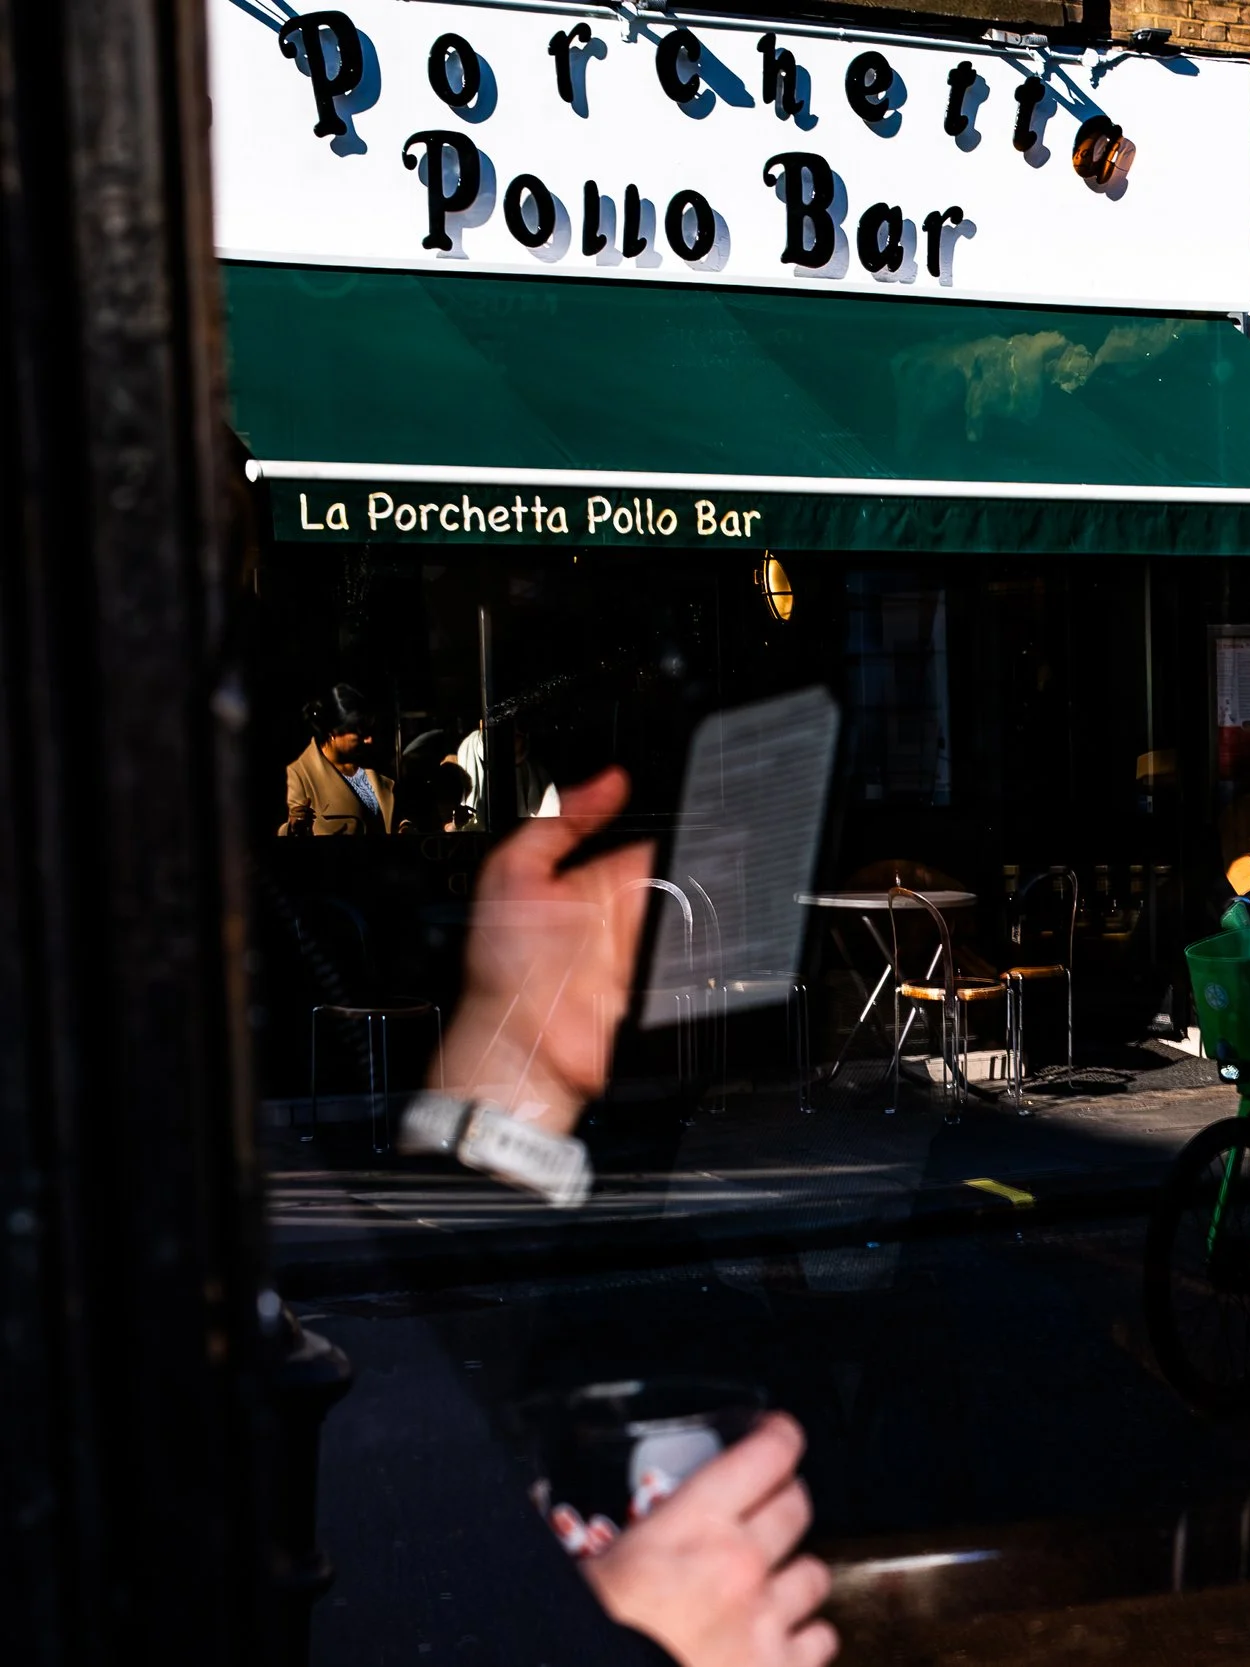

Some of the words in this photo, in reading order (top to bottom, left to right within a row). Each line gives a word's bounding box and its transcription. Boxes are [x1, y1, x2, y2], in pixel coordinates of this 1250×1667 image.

[279, 10, 1126, 186] Porchetta
[402, 130, 717, 263] Pollo
[763, 152, 965, 278] Bar
[299, 492, 350, 531] La
[367, 491, 569, 534] Porchetta
[587, 495, 678, 536] Pollo
[694, 499, 763, 538] Bar
